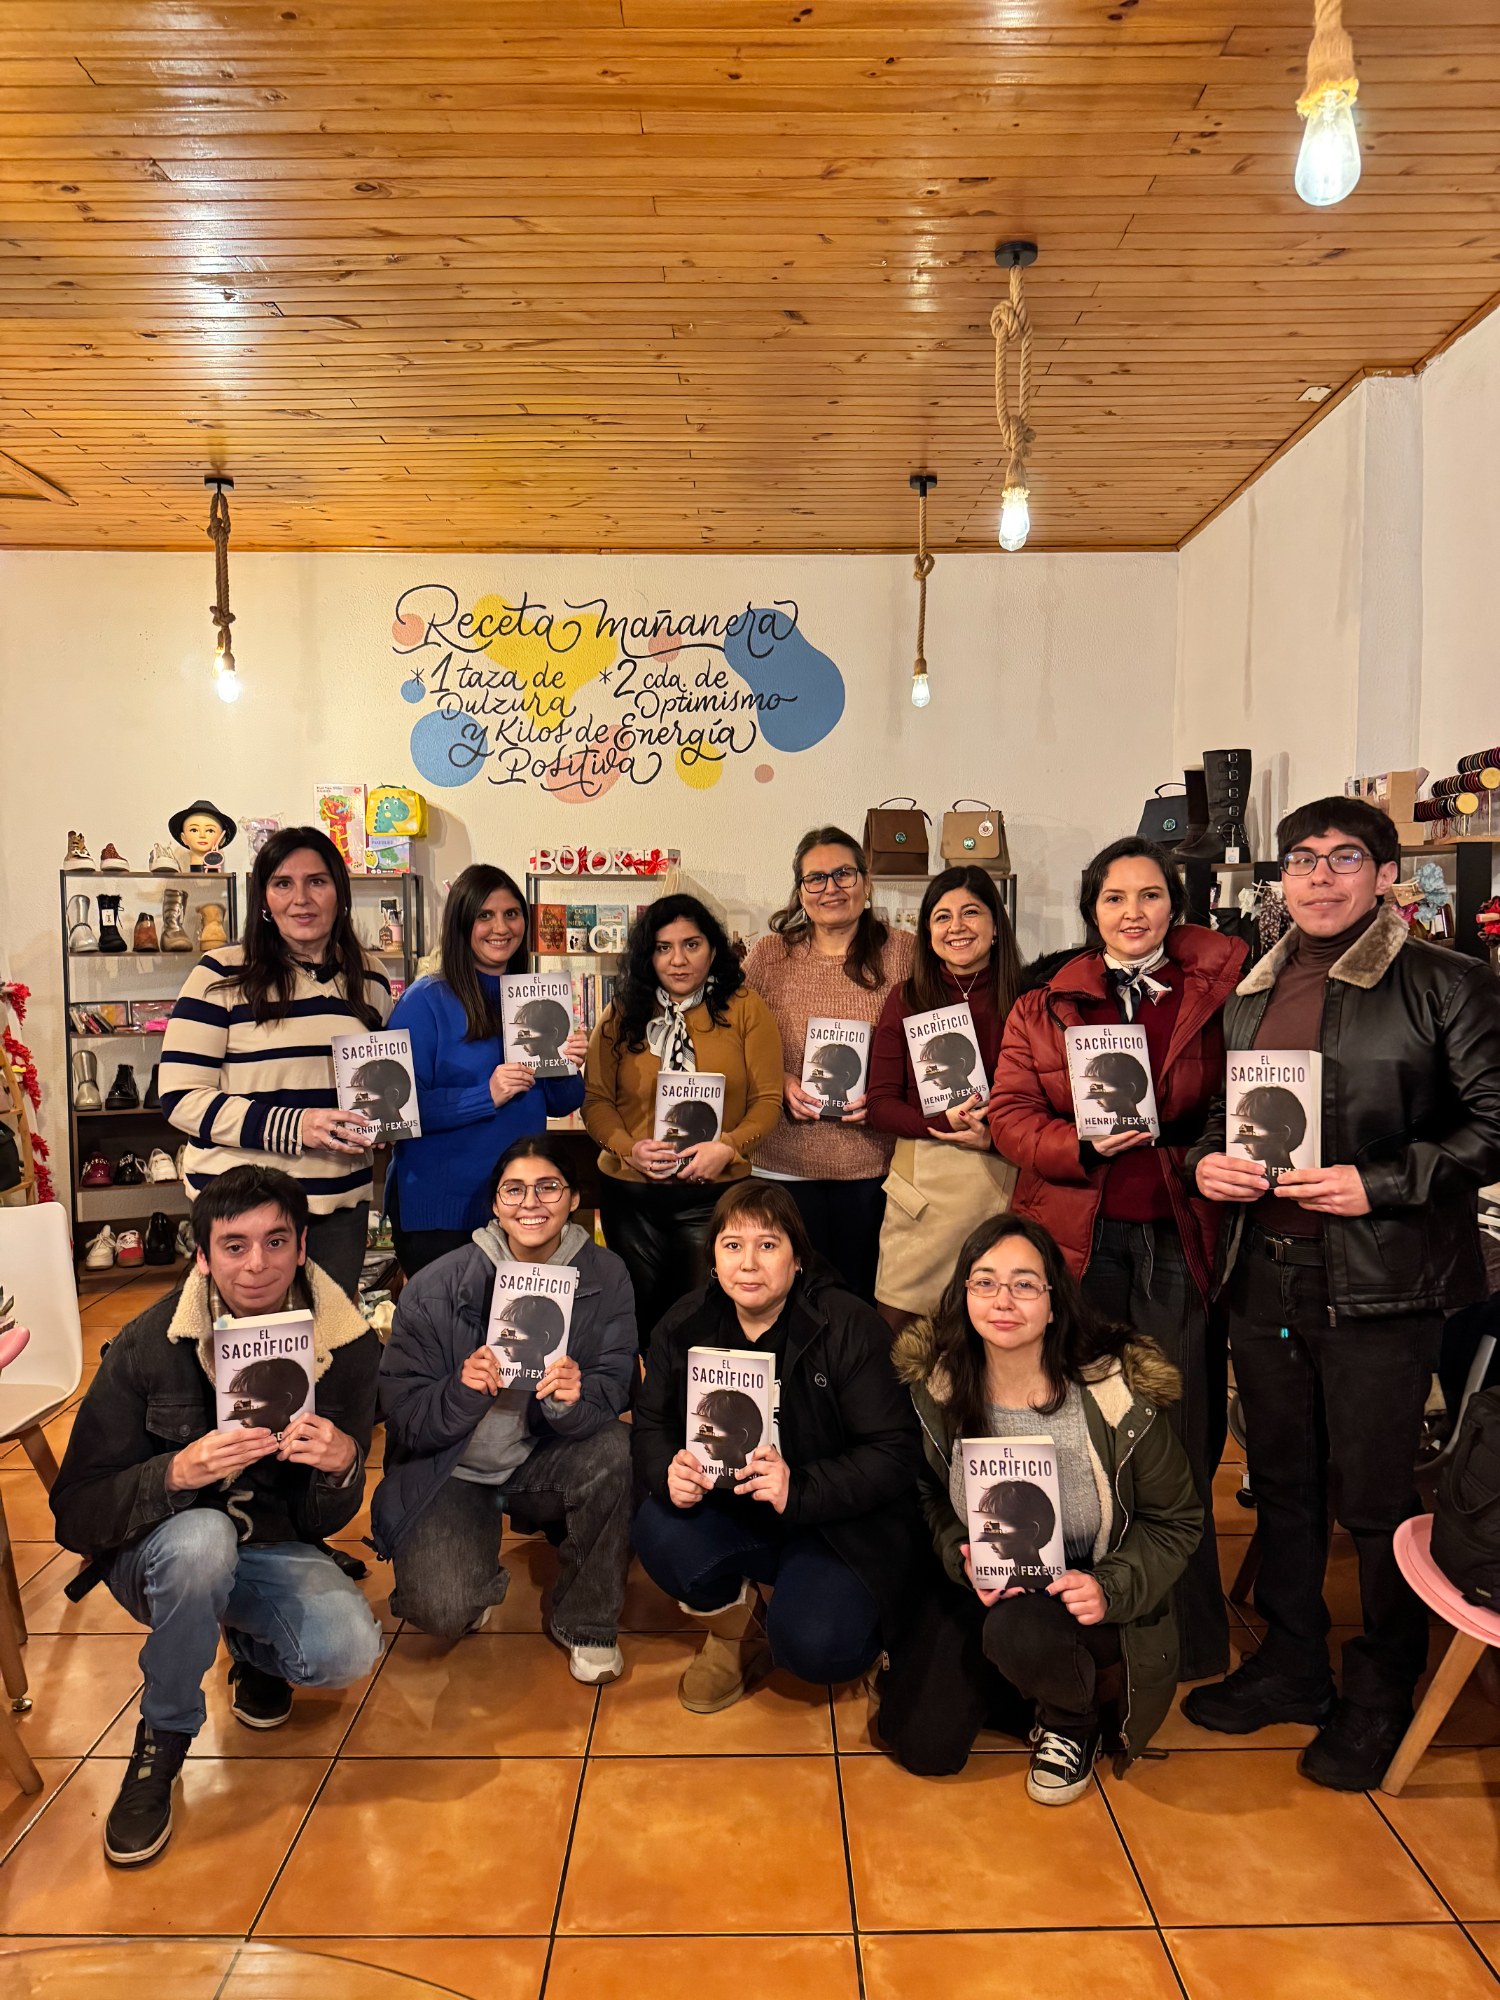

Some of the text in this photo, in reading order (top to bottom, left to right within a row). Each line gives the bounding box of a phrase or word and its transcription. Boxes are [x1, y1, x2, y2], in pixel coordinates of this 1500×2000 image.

[392, 584, 798, 659] Receta mañanera
[456, 659, 528, 691] taza
[532, 660, 566, 688] de
[694, 659, 728, 689] de
[437, 689, 577, 721] Dulzura
[634, 690, 798, 724] Optimismo
[449, 712, 757, 768] y Kilos de Energía
[488, 744, 662, 797] Positiva
[535, 848, 636, 875] BOOK
[534, 976, 541, 984] EL
[508, 984, 569, 998] SACRIFICIO
[932, 1012, 940, 1020] EL
[910, 1014, 969, 1038] SACRIFICIO
[1103, 1028, 1112, 1036] EL
[370, 1035, 378, 1044] EL
[810, 1029, 865, 1043] SACRIFICIO
[342, 1041, 407, 1060] SACRIFICIO
[1075, 1037, 1143, 1051] SACRIFICIO
[519, 1060, 541, 1068] NRIK
[1261, 1055, 1270, 1065] EL
[1231, 1066, 1305, 1082] SACRIFICIO
[688, 1077, 695, 1085] EL
[662, 1085, 721, 1098] SACRIFICIO
[924, 1092, 954, 1105] HENRIK
[385, 1119, 418, 1132] FEXEUS
[1085, 1116, 1156, 1126] HENRIK FEXEUS
[532, 1267, 541, 1276] EL
[500, 1275, 571, 1295] SACRIFICIO
[259, 1329, 270, 1340] EL
[222, 1335, 309, 1359] SACRIFICIO
[722, 1359, 731, 1369] EL
[498, 1367, 521, 1377] NRIK
[692, 1367, 764, 1389] SACRIFICIO
[1003, 1448, 1014, 1458] EL
[702, 1465, 725, 1477] NRIK
[970, 1460, 1052, 1477] SACRIFICIO
[976, 1565, 1063, 1576] HENRIK FEXEUS
